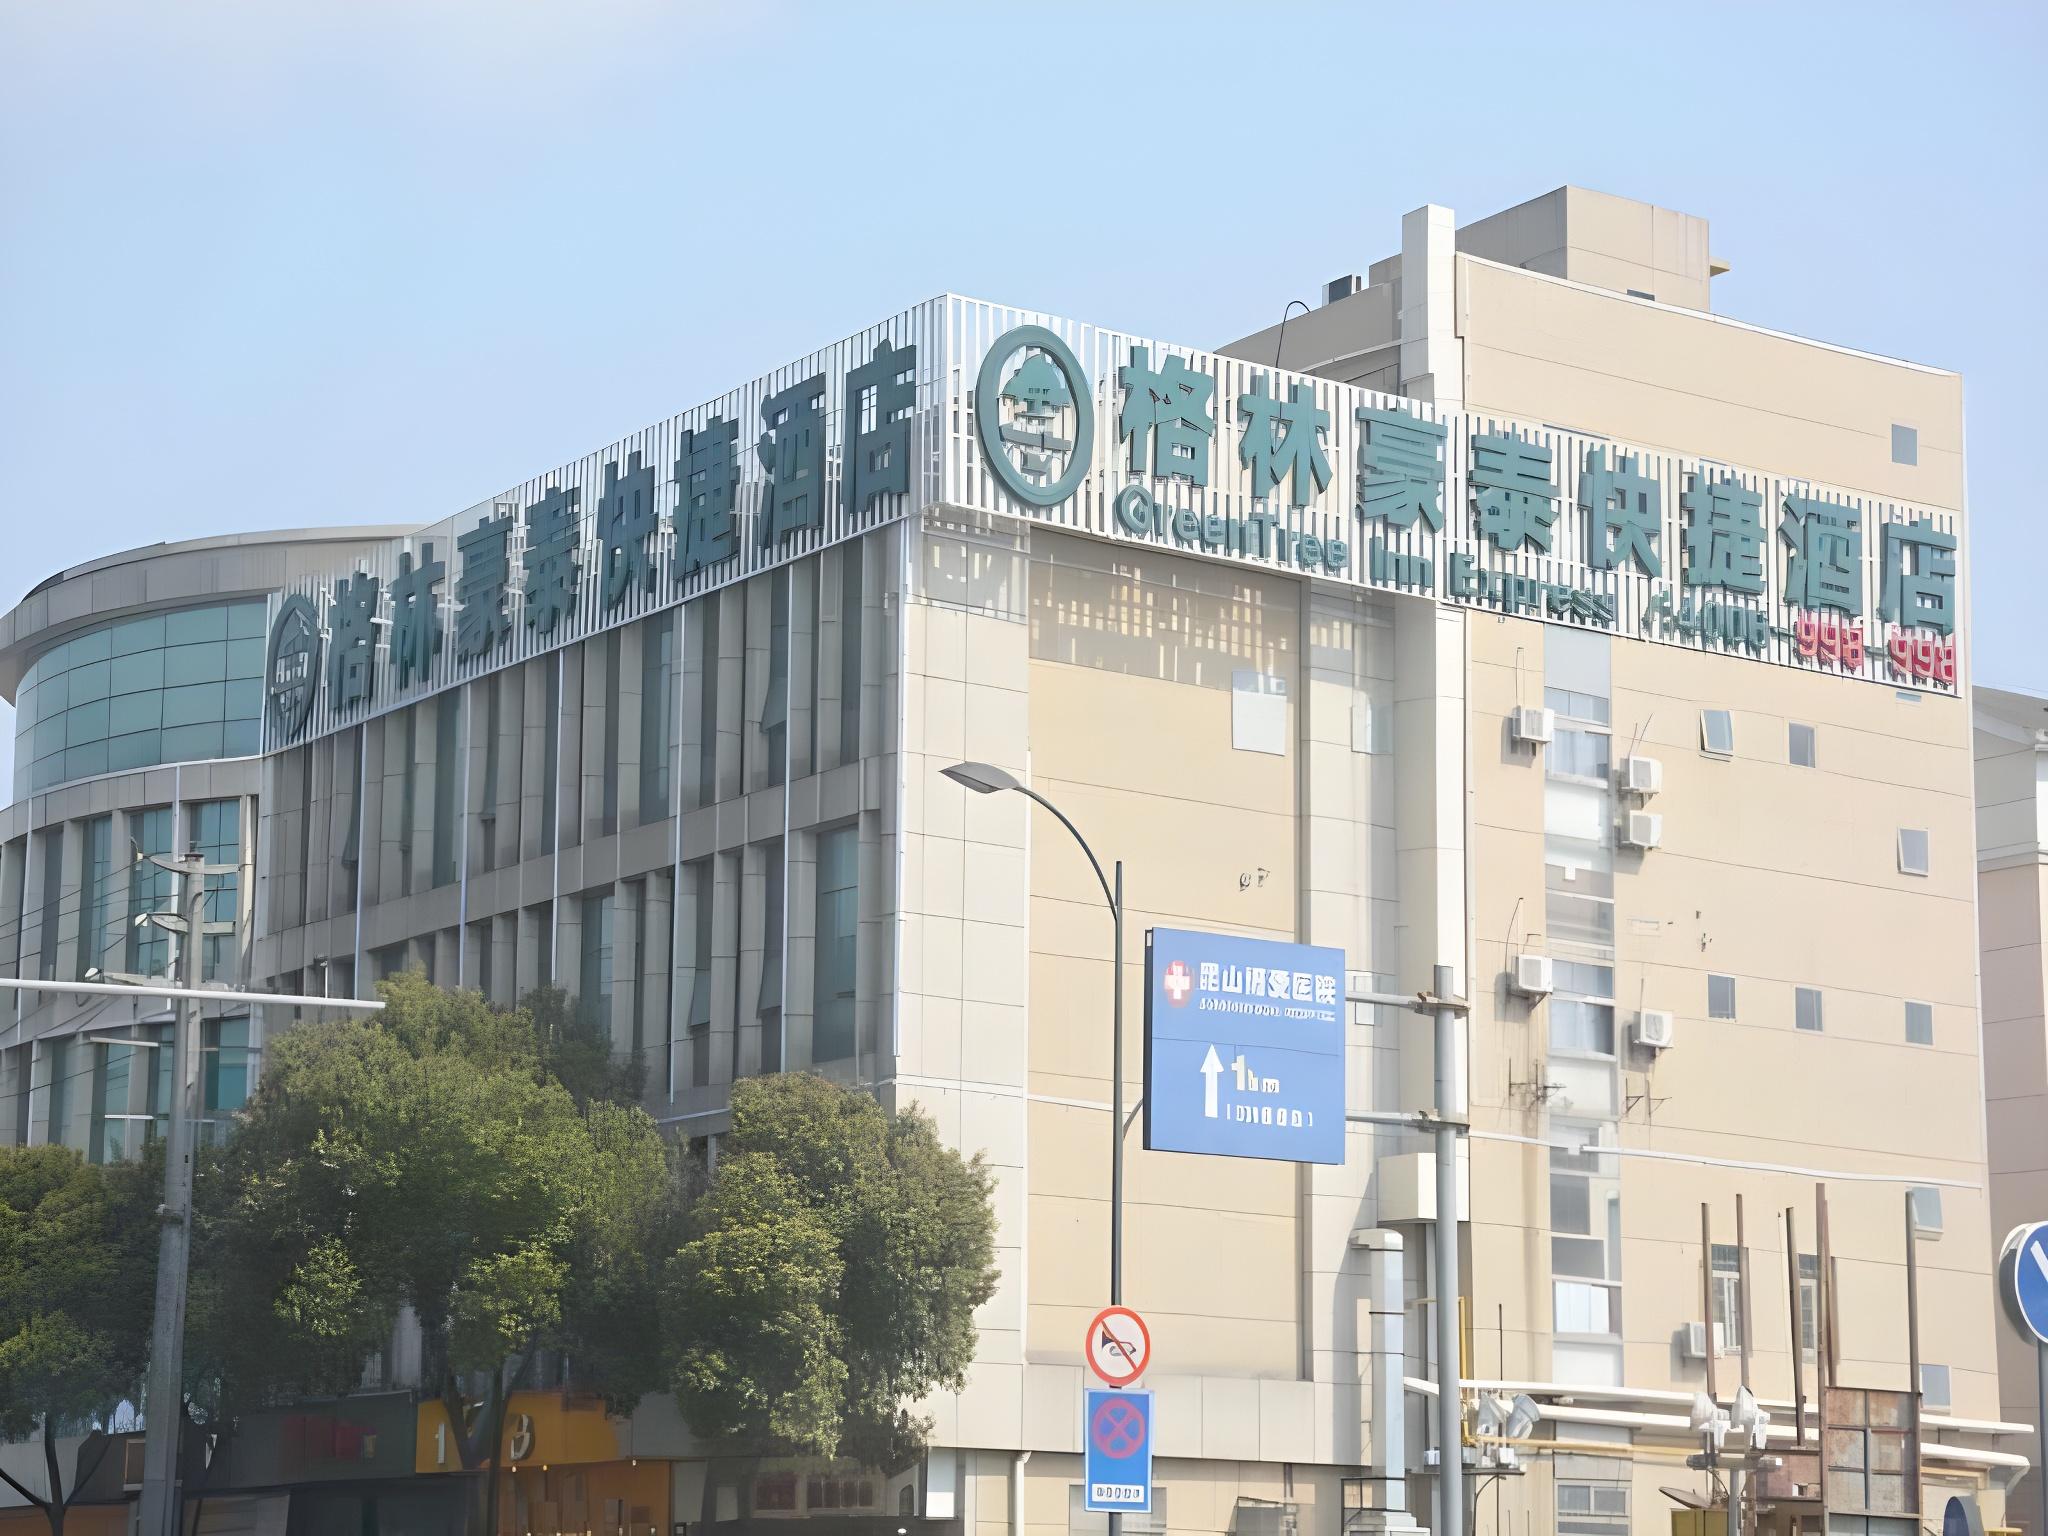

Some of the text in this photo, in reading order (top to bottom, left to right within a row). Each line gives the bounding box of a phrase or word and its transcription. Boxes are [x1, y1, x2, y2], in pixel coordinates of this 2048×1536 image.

[329, 338, 917, 712] 格林豪泰快捷酒店
[1119, 345, 1957, 635] 格林豪泰快捷酒店
